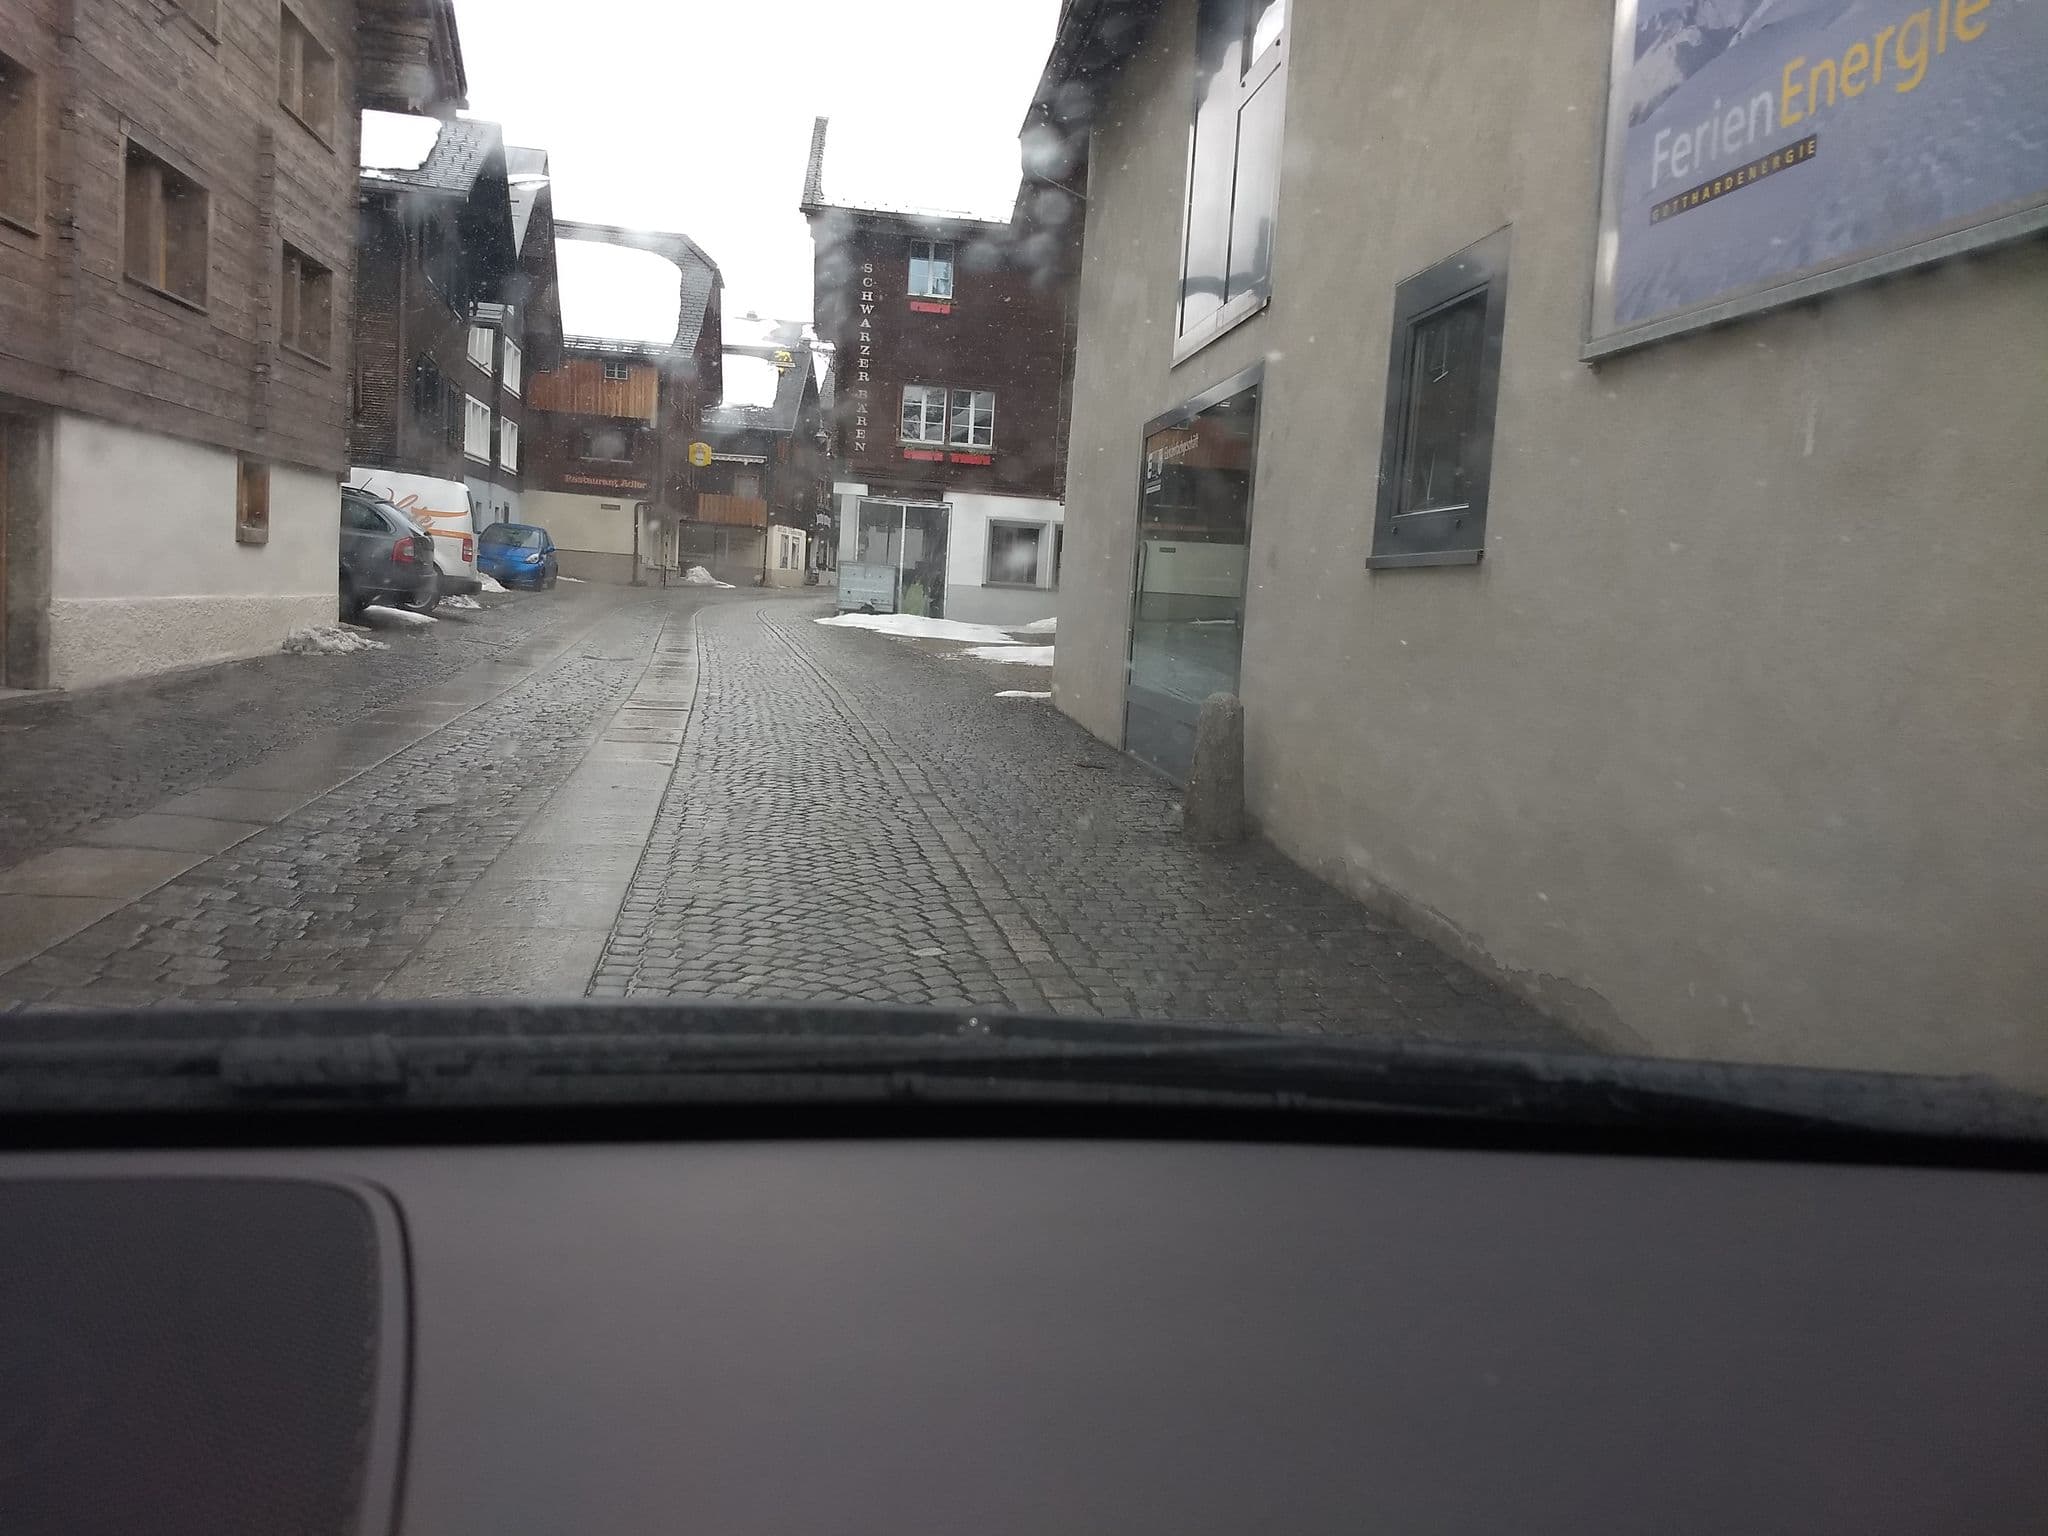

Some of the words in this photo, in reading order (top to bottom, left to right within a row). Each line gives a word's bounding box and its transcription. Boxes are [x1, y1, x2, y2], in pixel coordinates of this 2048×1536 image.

[1651, 140, 1816, 222] GOTTHARDENERGIE
[858, 263, 875, 381] SCHWARZER
[564, 474, 618, 488] Restaurant
[620, 479, 648, 489] Adler
